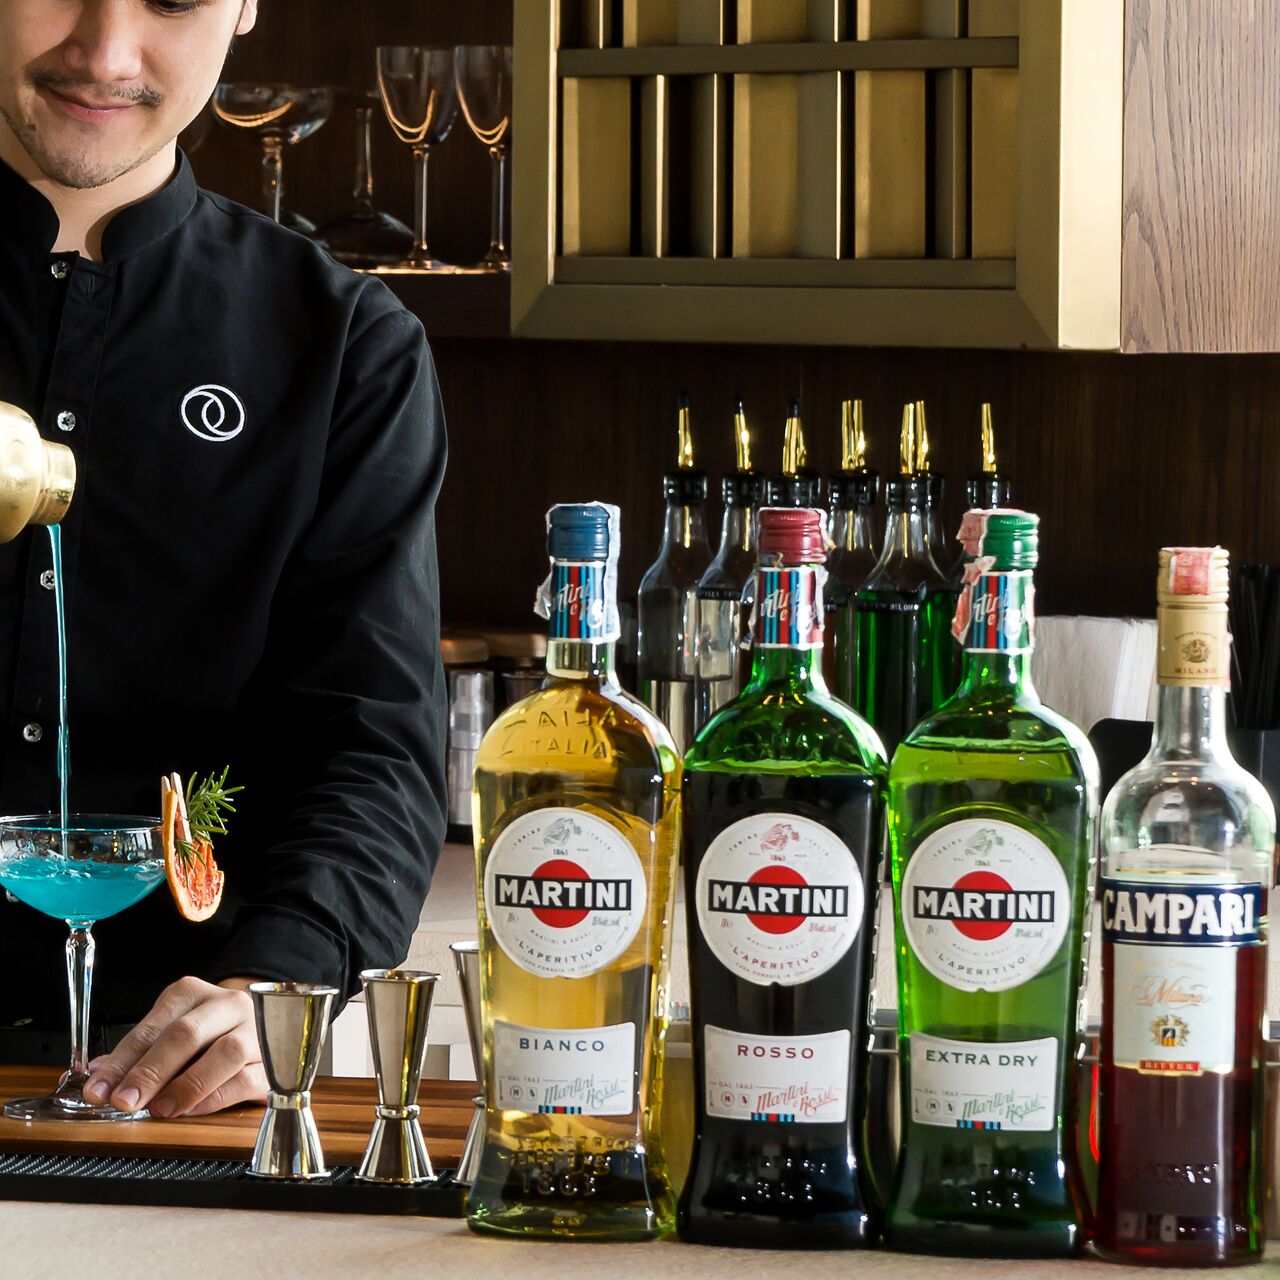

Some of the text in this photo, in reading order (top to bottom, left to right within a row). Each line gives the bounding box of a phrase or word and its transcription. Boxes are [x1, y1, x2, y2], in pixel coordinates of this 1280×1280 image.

[499, 877, 628, 908] MARTINI
[713, 884, 845, 915] MARTINI
[918, 889, 1051, 920] MARTINI
[1103, 889, 1255, 937] CAMPARI
[518, 940, 603, 964] L'APERITIVO
[732, 947, 821, 970] L'APERITIVO
[937, 953, 1026, 976] L'APERITIVO
[519, 1037, 605, 1052] BIANCO
[737, 1044, 814, 1059] ROSSO
[925, 1049, 1038, 1066] EXTRA DRY
[1144, 1061, 1194, 1071] BITTER
